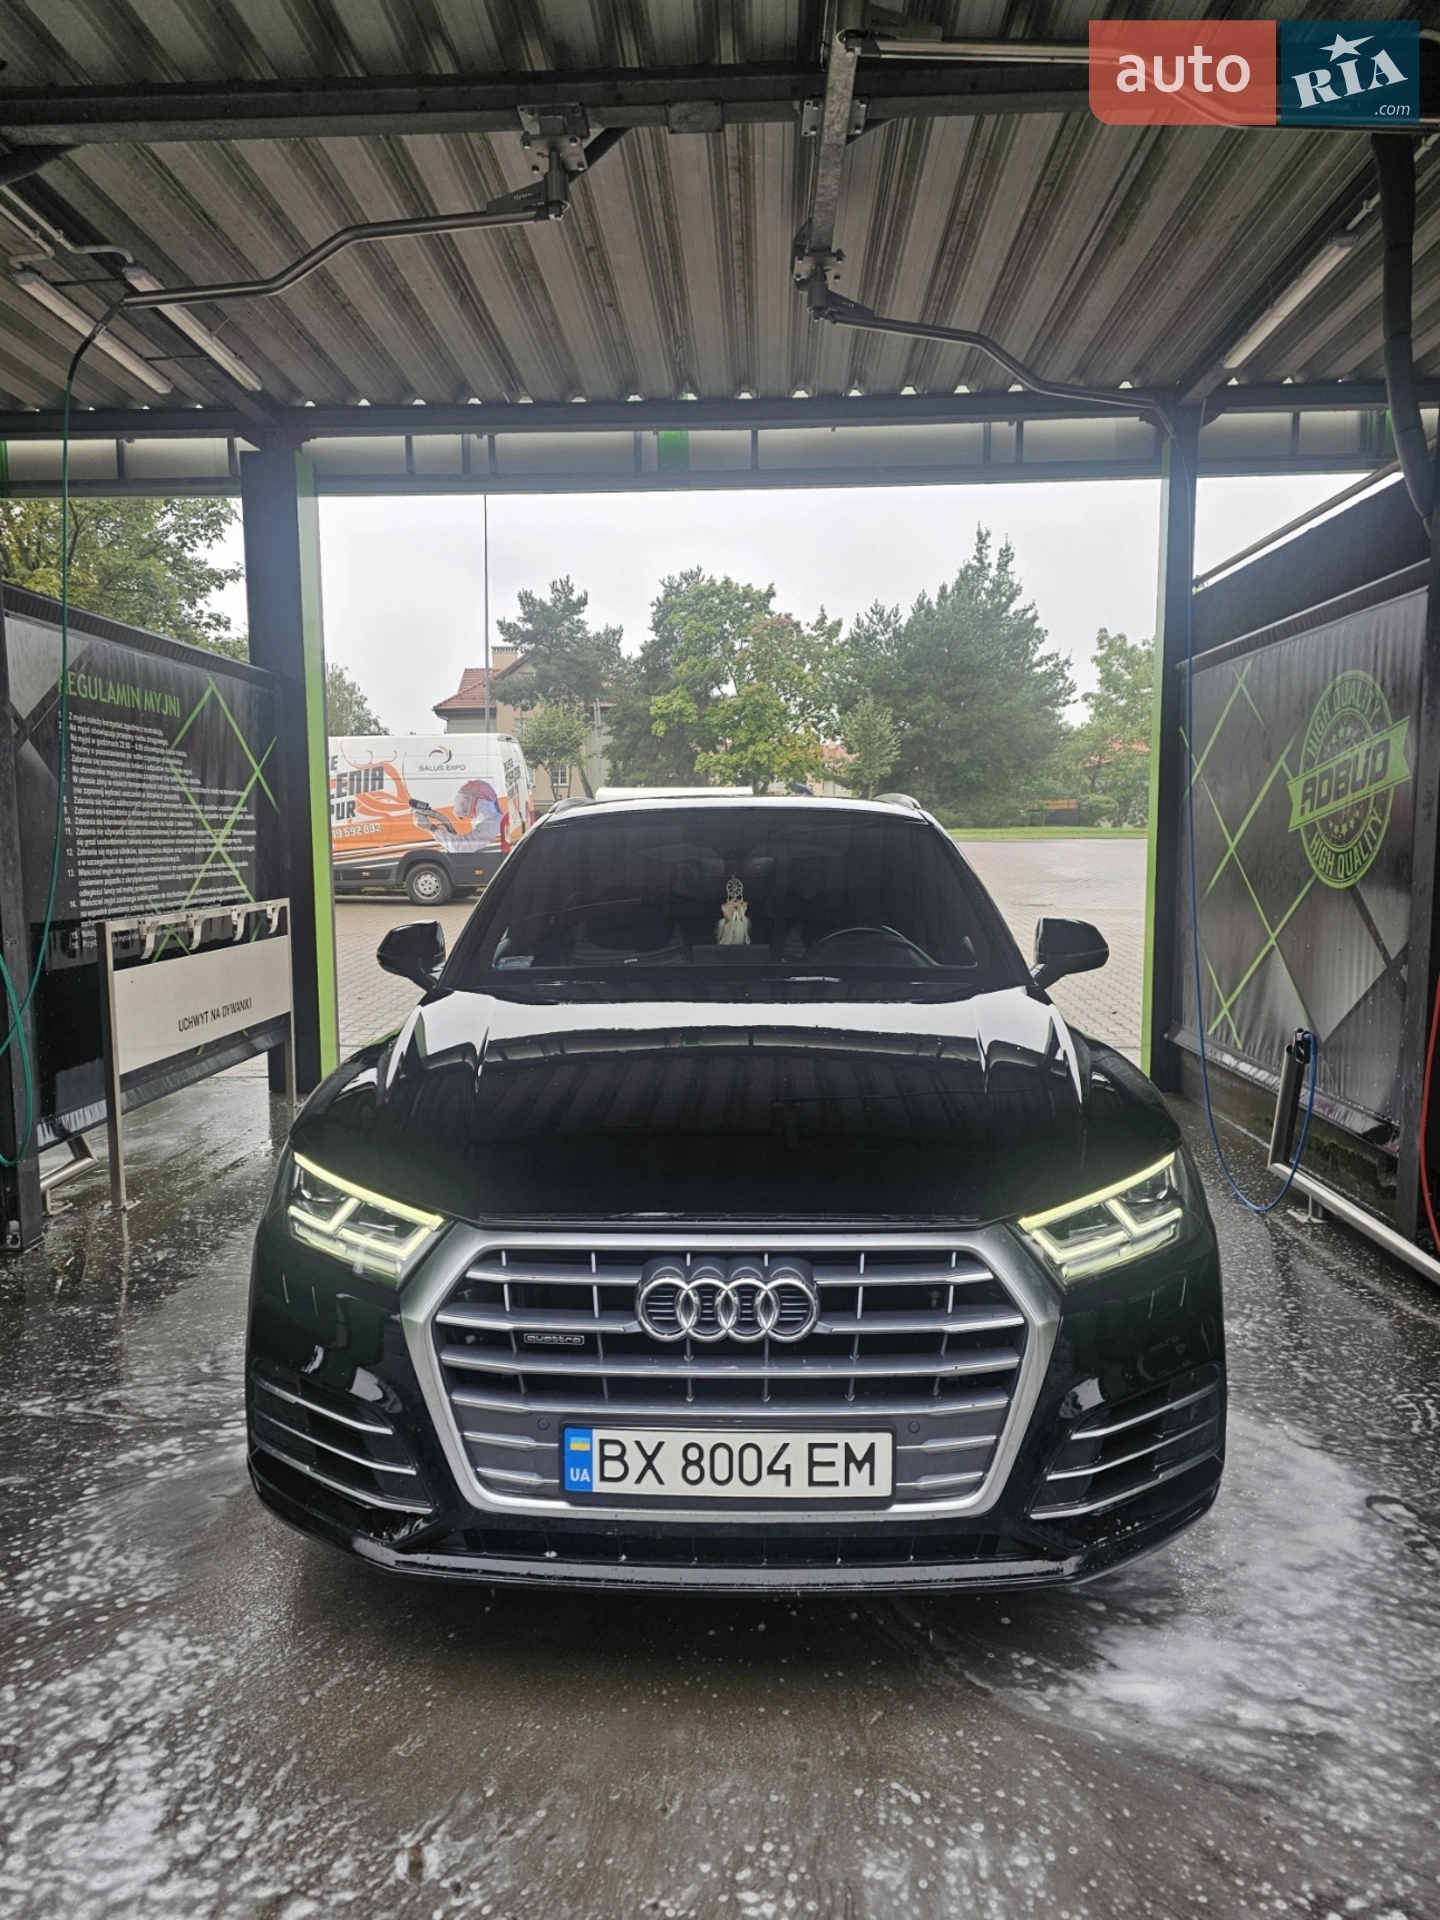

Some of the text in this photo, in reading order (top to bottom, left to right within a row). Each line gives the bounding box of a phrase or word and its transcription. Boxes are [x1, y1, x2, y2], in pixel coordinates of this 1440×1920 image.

[144, 689, 180, 718] MYJNI
[1307, 680, 1382, 758] HIGH QUALITY
[330, 766, 384, 799] ENIA
[418, 764, 444, 772] SALUS
[344, 826, 362, 837] 592
[363, 822, 381, 834] 892
[1309, 808, 1384, 880] HIGH QUALITY
[178, 997, 252, 1032] UCHWYT NA DYWANKI
[526, 1335, 582, 1344] quattro
[570, 1438, 876, 1488] UA BX 8004 EM
